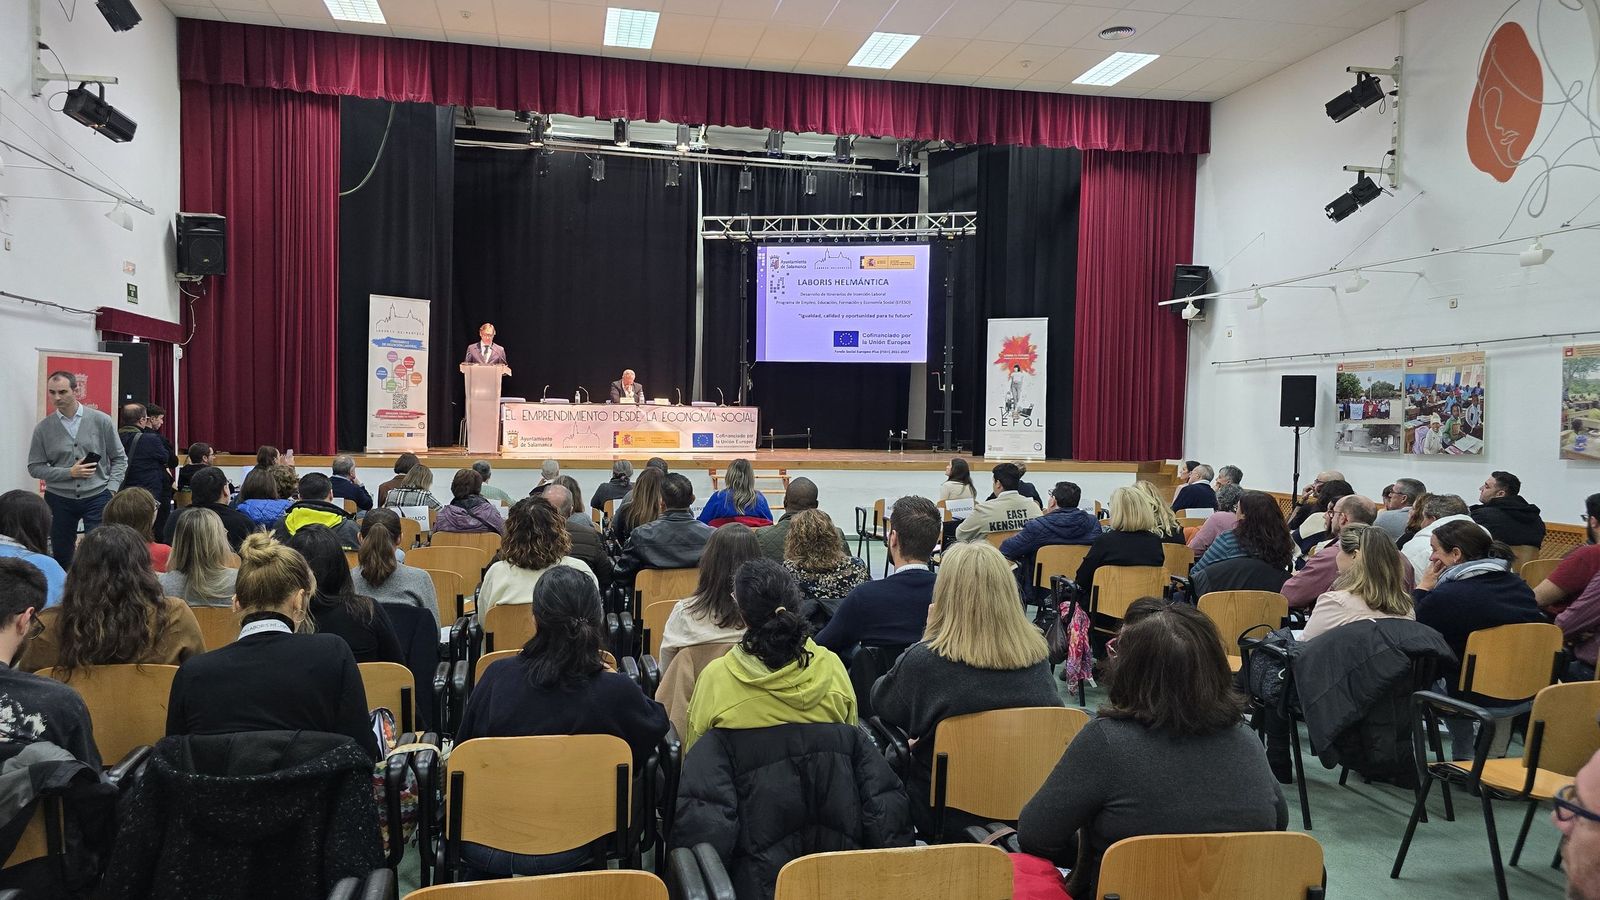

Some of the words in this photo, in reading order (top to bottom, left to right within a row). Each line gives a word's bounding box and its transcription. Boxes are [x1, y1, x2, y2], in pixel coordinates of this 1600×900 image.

[834, 277, 889, 286] HELMÁNTICA
[505, 409, 516, 421] EL
[522, 409, 608, 422] EMPRENDIMIENTO
[613, 410, 641, 422] DESDE
[646, 412, 657, 422] LA
[662, 409, 716, 422] ECONOMÍA
[721, 412, 755, 423] SOCIAL
[988, 418, 1043, 427] CEFOL
[1006, 509, 1027, 519] EAST
